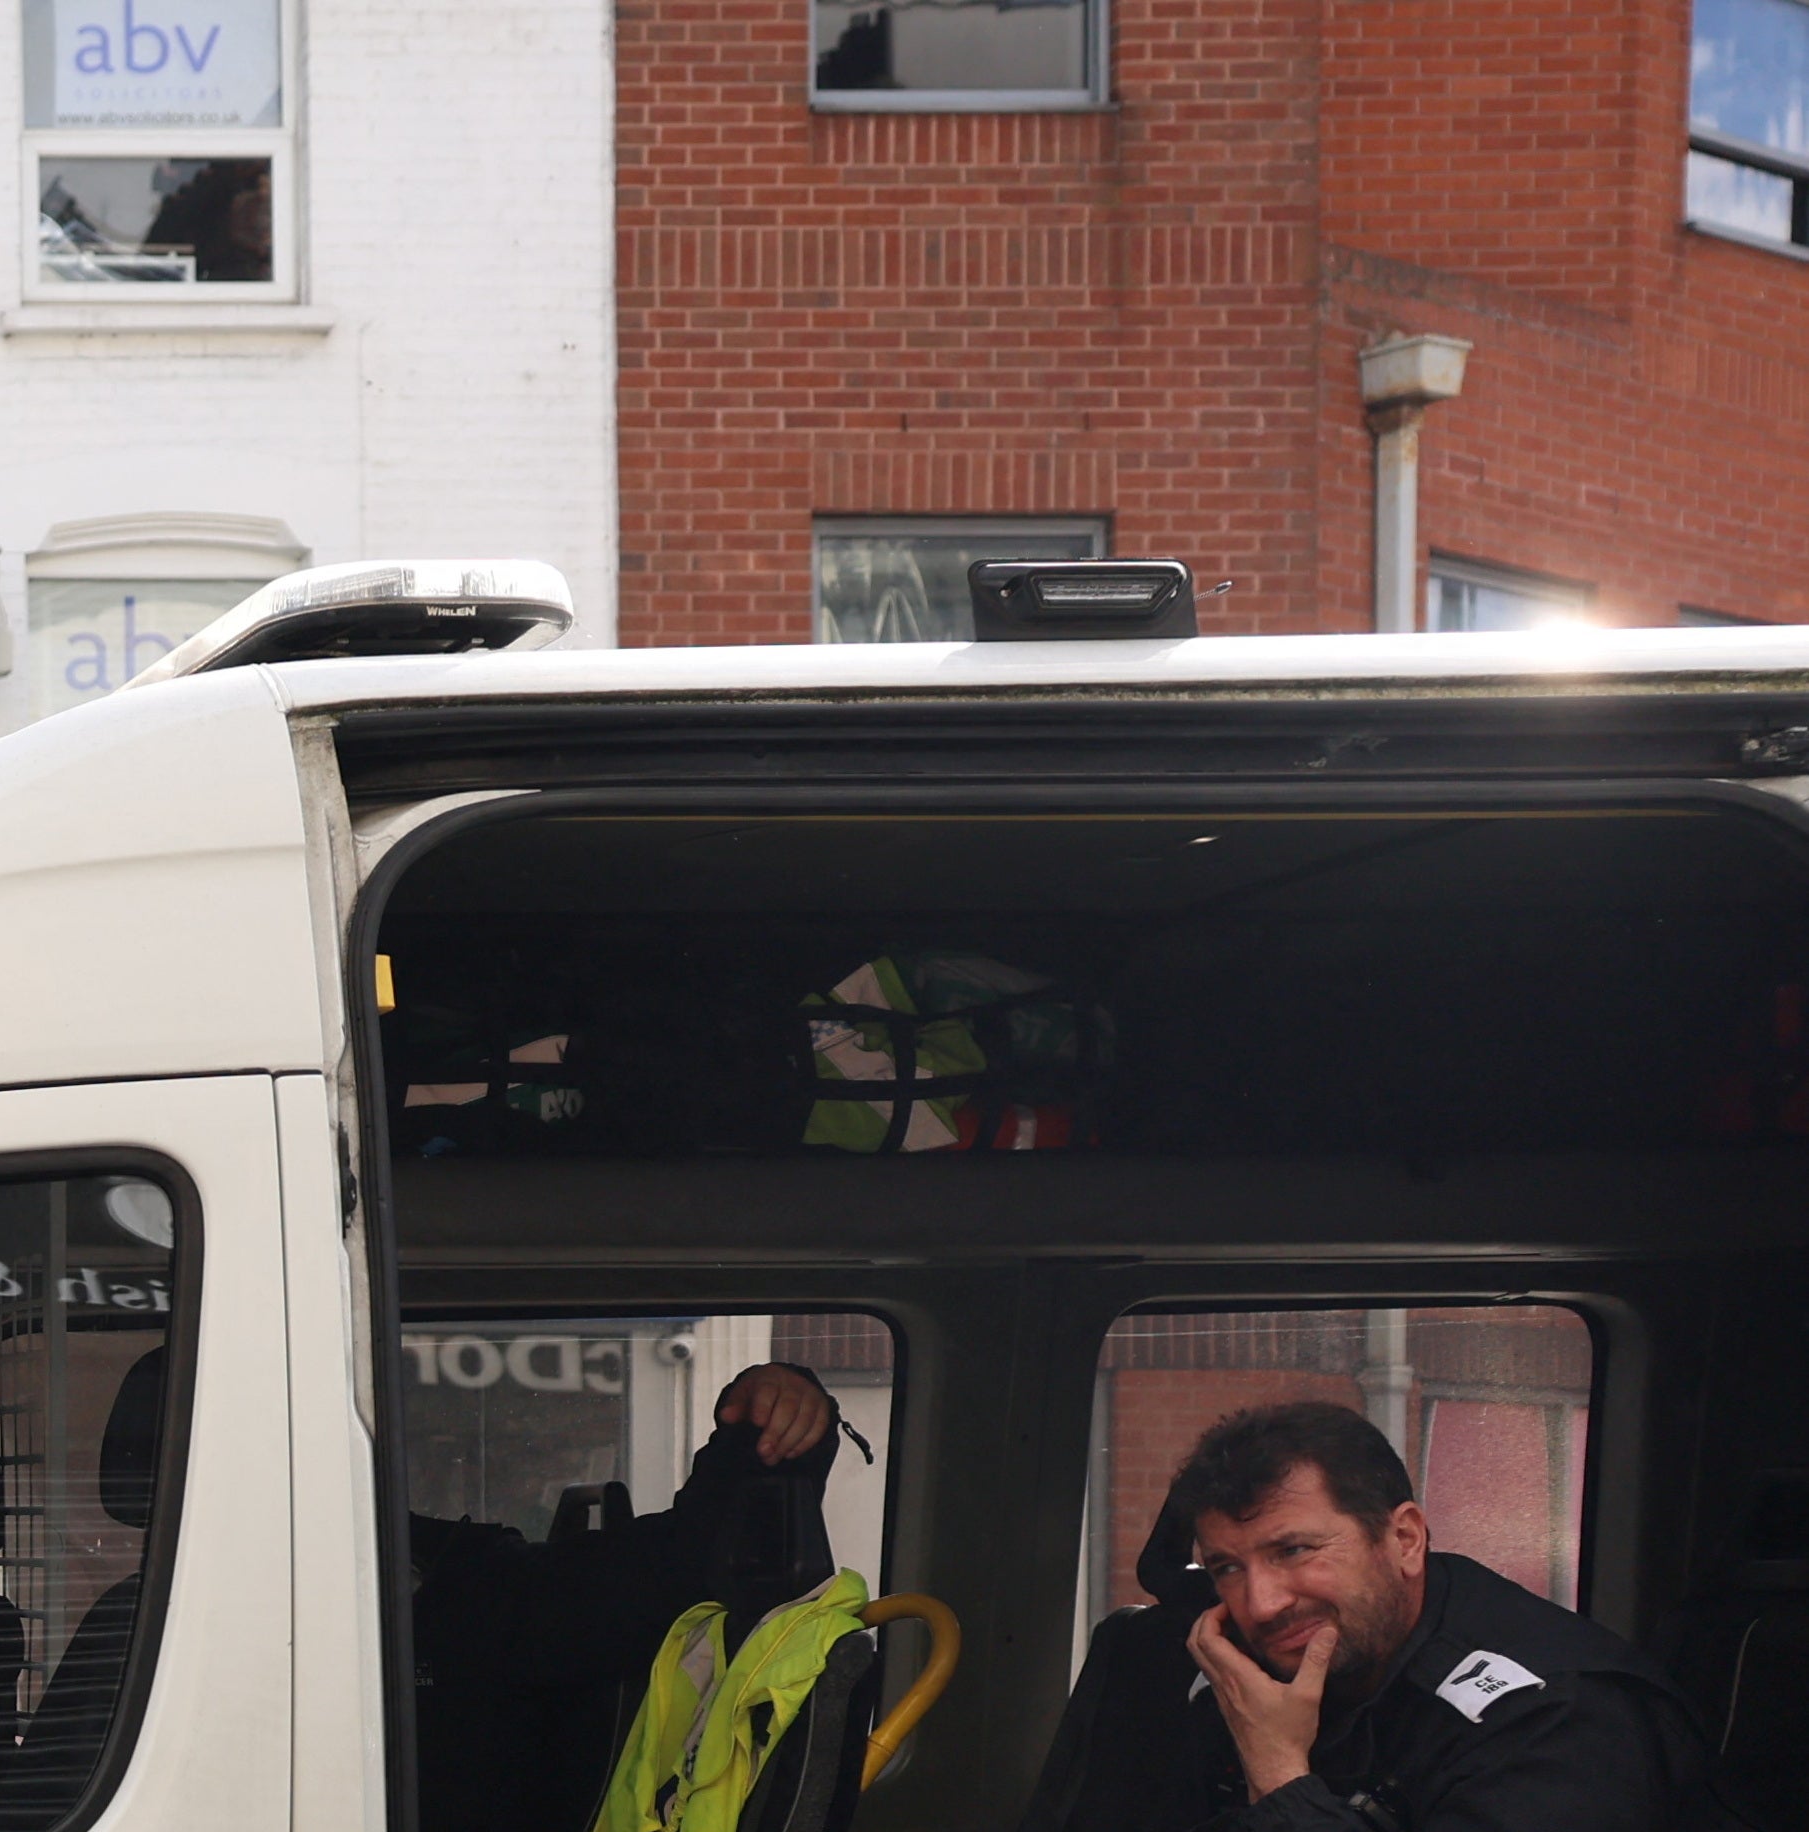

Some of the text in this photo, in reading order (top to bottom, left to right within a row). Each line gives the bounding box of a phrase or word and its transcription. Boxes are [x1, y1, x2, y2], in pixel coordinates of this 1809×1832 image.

[74, 0, 222, 75] abv
[73, 87, 223, 100] SOLICITORS
[425, 605, 479, 617] WHELEN
[65, 595, 192, 691] ab
[1475, 1674, 1499, 1688] CE
